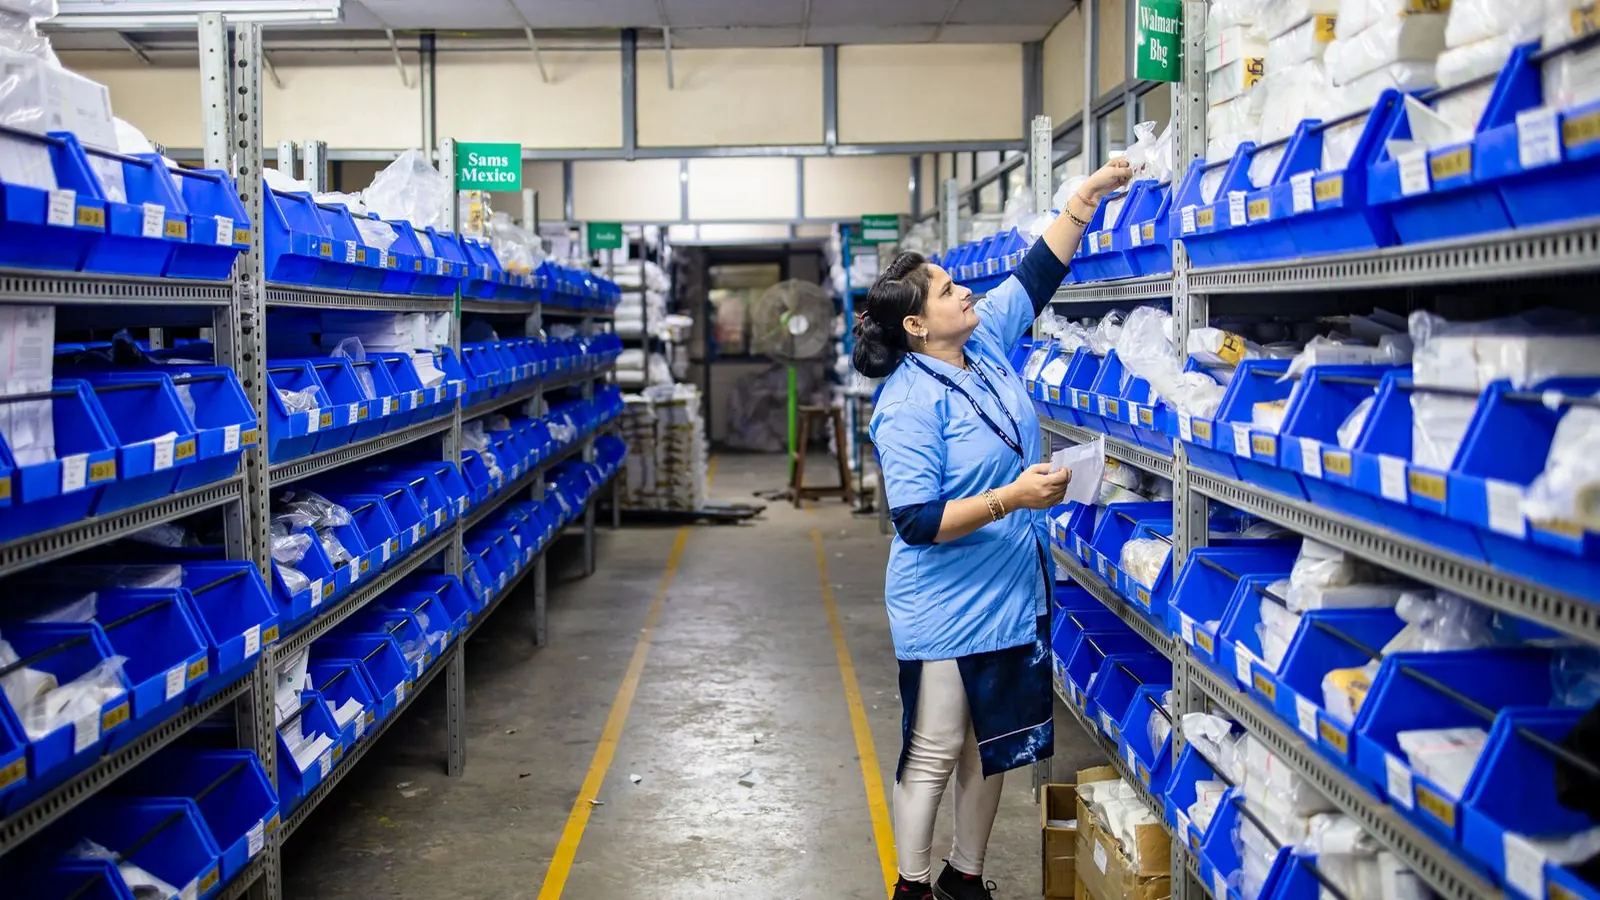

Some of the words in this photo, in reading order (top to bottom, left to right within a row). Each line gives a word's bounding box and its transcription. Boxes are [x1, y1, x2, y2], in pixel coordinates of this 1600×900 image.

[1140, 6, 1179, 35] Walmart
[1149, 37, 1168, 68] Bhg
[468, 152, 509, 167] Sams
[461, 167, 516, 183] Mexico
